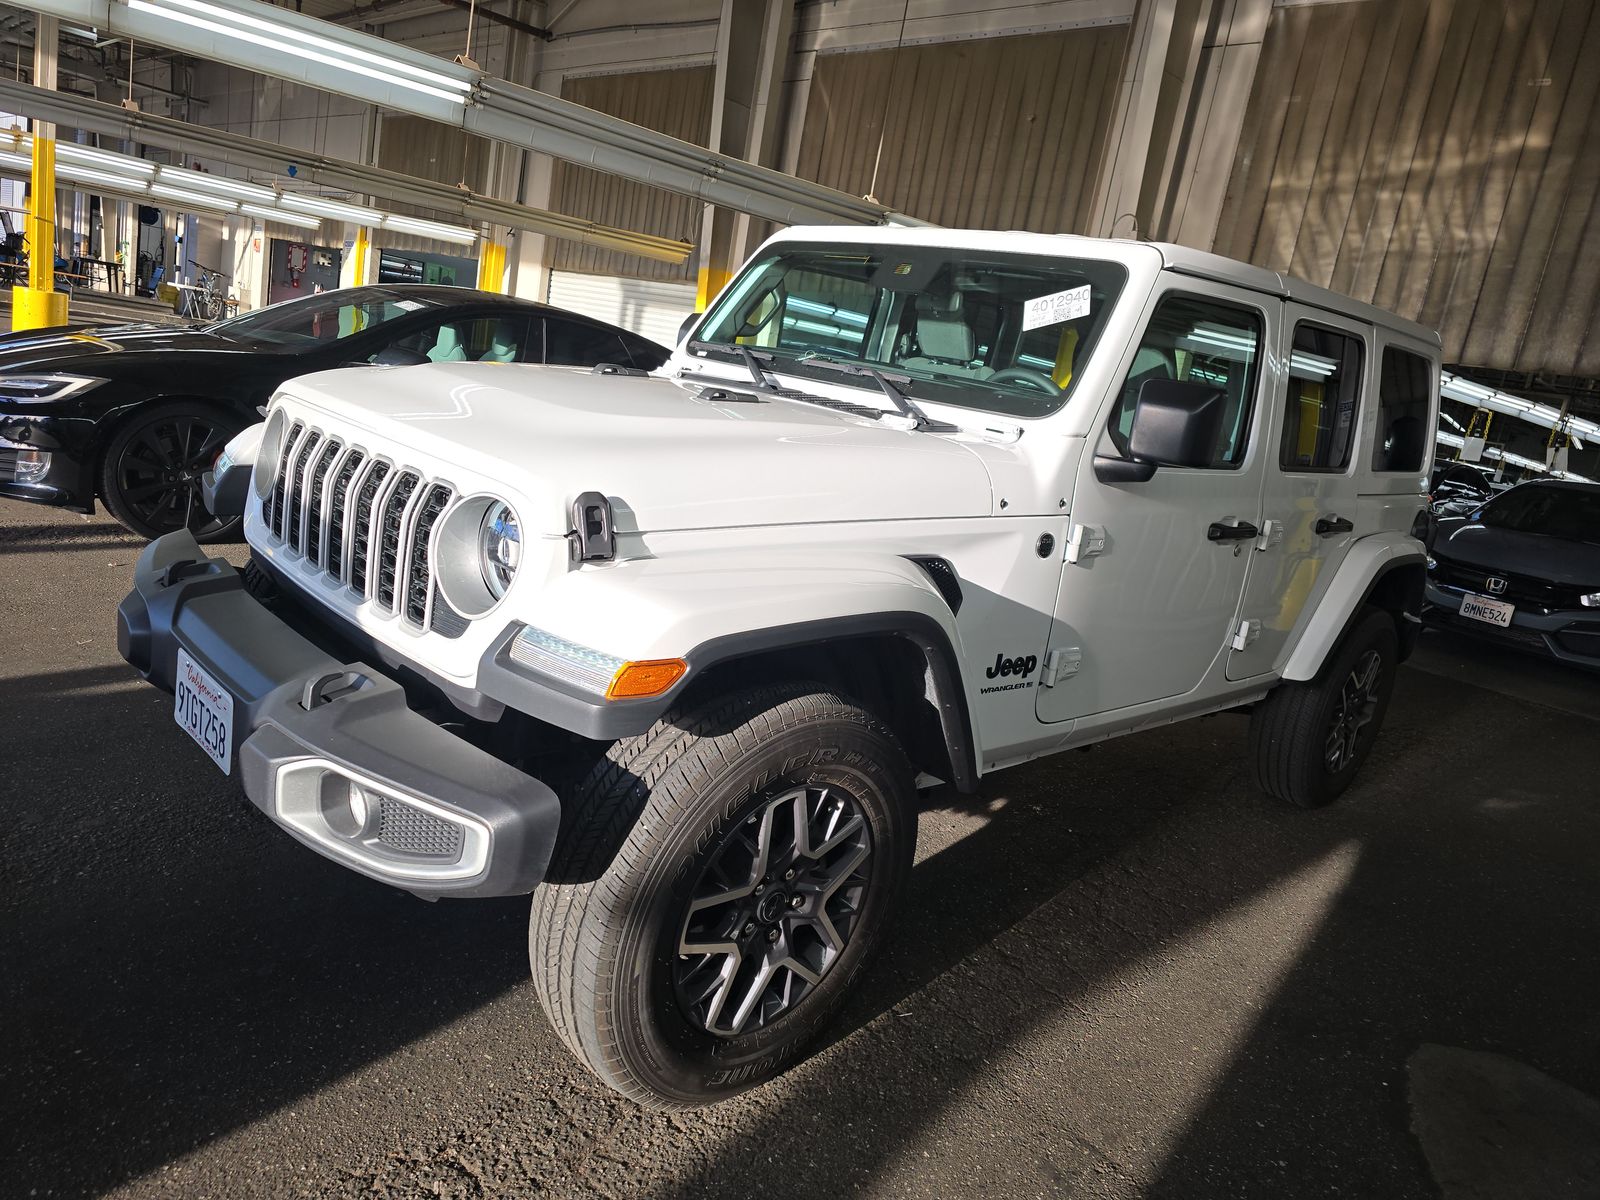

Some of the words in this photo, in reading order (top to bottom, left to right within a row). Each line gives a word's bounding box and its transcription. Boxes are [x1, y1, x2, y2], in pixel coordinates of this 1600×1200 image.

[1031, 288, 1090, 313] 4012940
[1463, 602, 1507, 623] 8MNE524
[986, 653, 1037, 679] Jeep
[186, 665, 222, 711] California
[980, 682, 1026, 694] WRANGLER
[178, 680, 227, 759] 9TGT258
